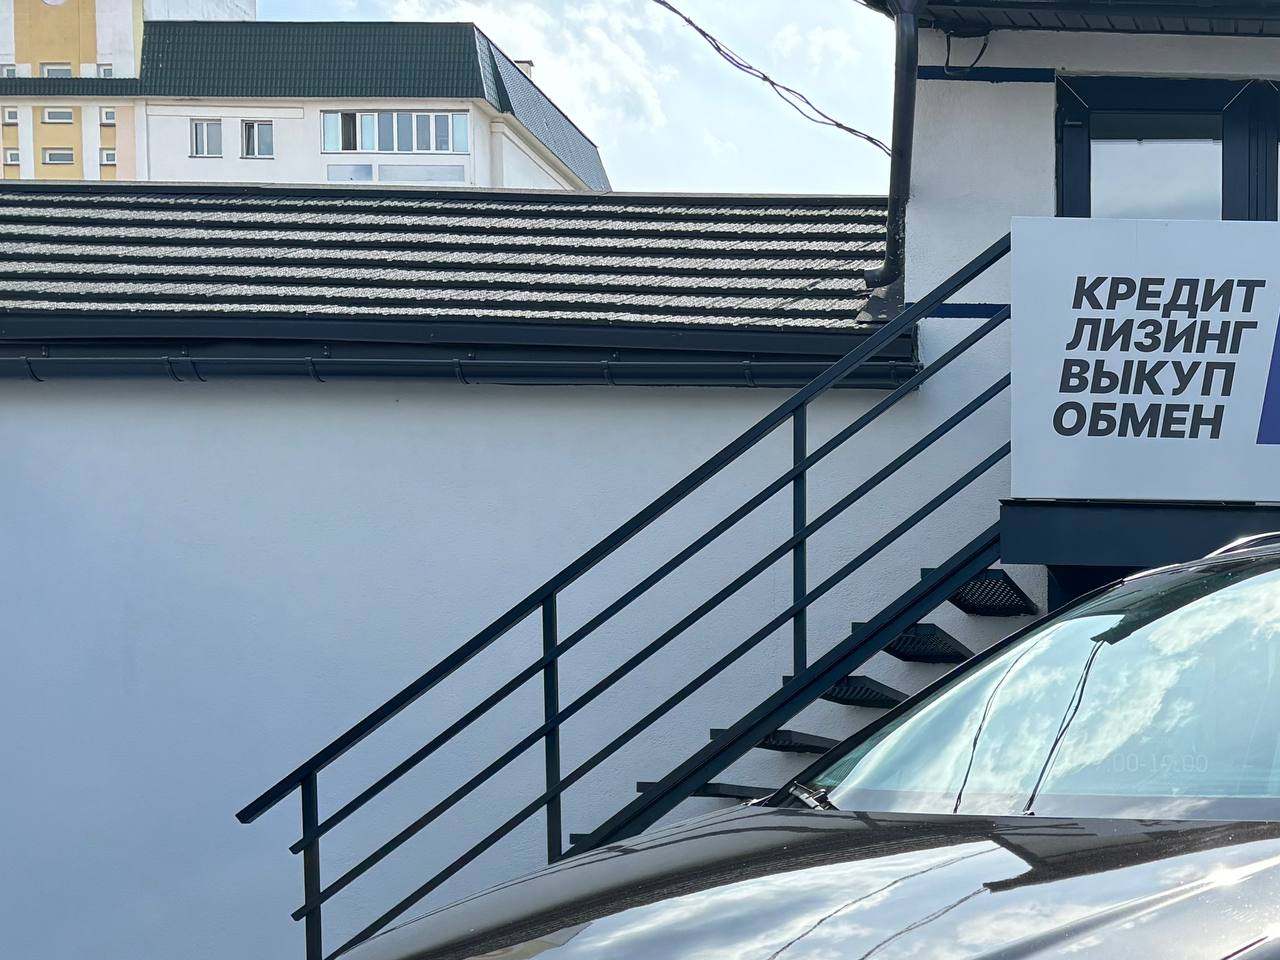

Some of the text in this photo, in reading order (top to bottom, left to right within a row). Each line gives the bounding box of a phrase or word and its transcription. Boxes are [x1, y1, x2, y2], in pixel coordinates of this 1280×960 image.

[1072, 276, 1266, 319] КРЕДИТ
[1065, 317, 1258, 354] ЛИЗИНГ
[1059, 358, 1236, 396] ВЫКУП
[1053, 401, 1225, 439] ОБМЕН
